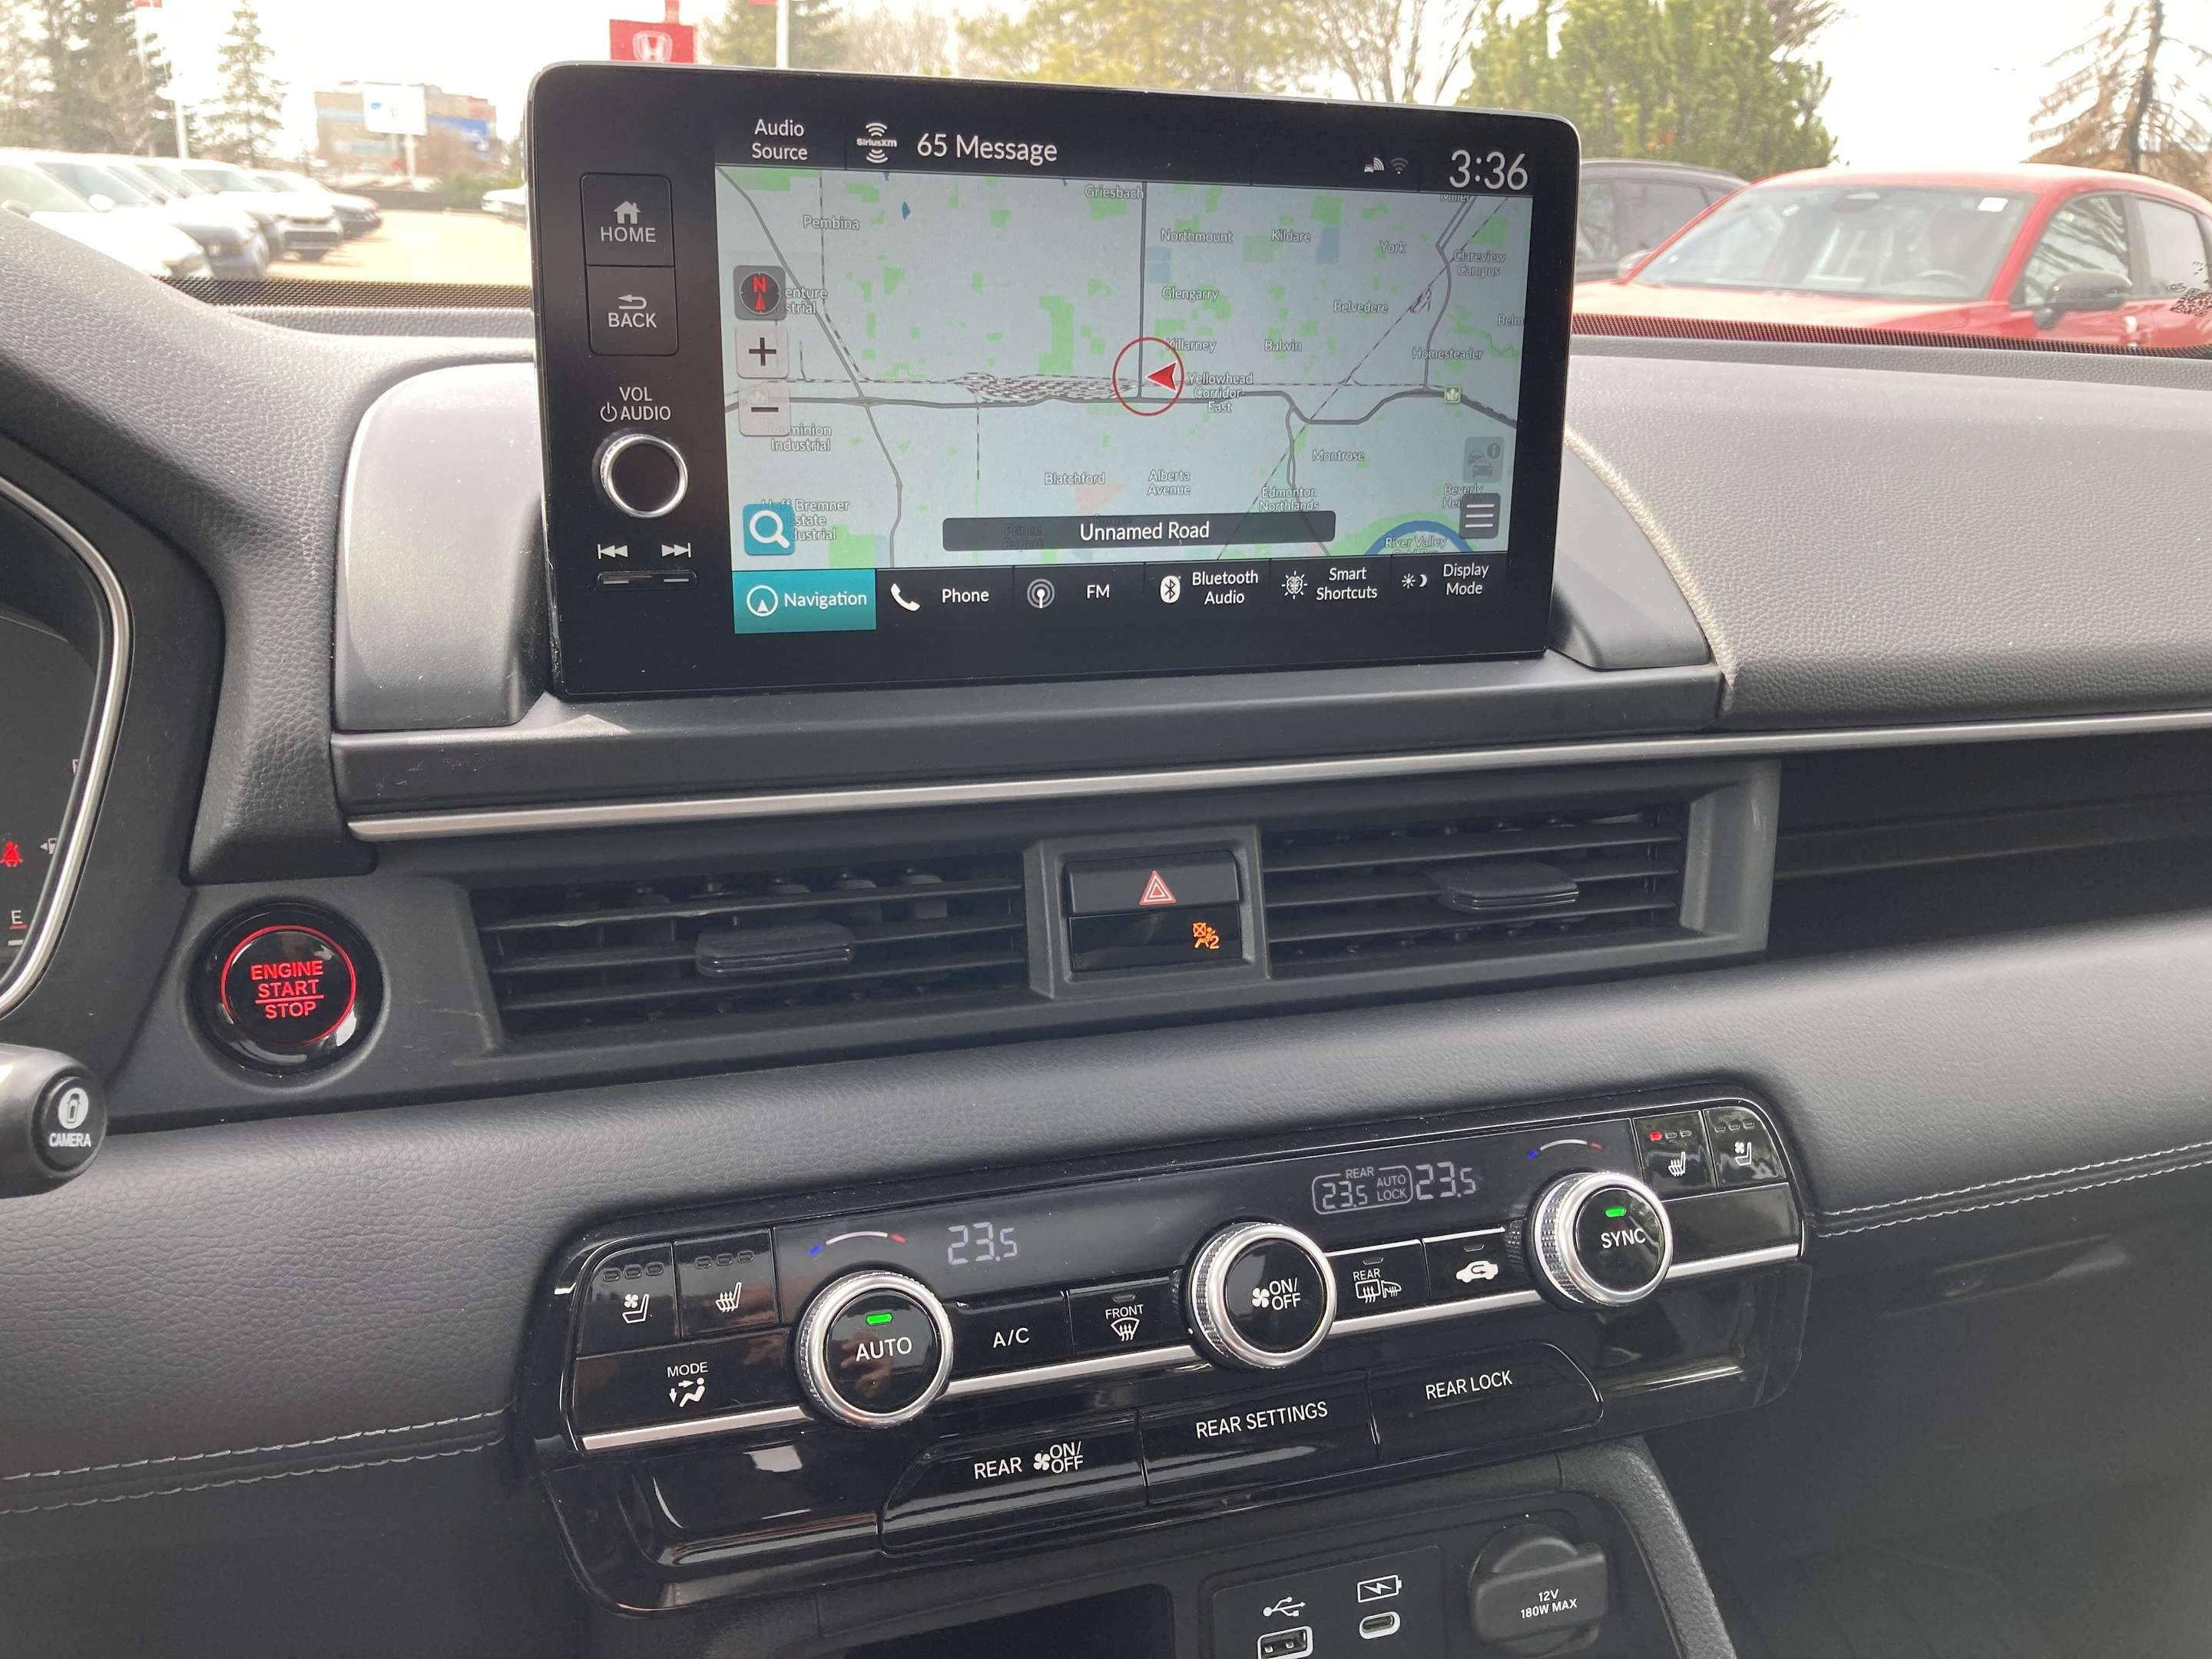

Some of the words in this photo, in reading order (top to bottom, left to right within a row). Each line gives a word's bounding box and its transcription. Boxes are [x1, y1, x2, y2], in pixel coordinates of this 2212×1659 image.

[754, 118, 804, 137] Audio
[752, 142, 808, 161] Source
[917, 133, 947, 157] 65
[956, 134, 1058, 167] Message
[1449, 150, 1528, 190] 3:36
[1084, 185, 1144, 200] Griesbach
[803, 215, 859, 230] Pembina
[601, 227, 656, 243] HOME
[1161, 229, 1233, 243] Northmount
[1271, 229, 1311, 243] Kildare
[1380, 240, 1406, 254] York
[1453, 250, 1505, 263] Clareview
[1457, 264, 1500, 278] Campus
[785, 286, 828, 299] enture
[1161, 286, 1219, 303] Glengarry
[786, 301, 816, 314] strial
[1333, 300, 1388, 313] Belvedere
[608, 312, 657, 329] BACK
[1498, 314, 1525, 326] Belm
[1166, 339, 1216, 354] Killarney
[1264, 339, 1302, 352] Balwin
[1412, 346, 1482, 361] Homesteader
[1187, 372, 1253, 385] Yellowhead
[619, 386, 653, 402] VOL
[1207, 400, 1233, 412] East
[621, 406, 671, 422] AUDIO
[790, 423, 832, 436] minion
[770, 439, 832, 452] Industrial
[1312, 449, 1365, 462] Montrose
[1045, 472, 1105, 485] Blatchford
[1147, 469, 1190, 482] Alberta
[1147, 485, 1190, 495] Avenue
[1261, 485, 1318, 500] Edmonton
[795, 499, 850, 512] Bremner
[1259, 499, 1319, 513] Northlands
[1080, 522, 1163, 541] Unnamed
[1168, 522, 1210, 539] Road
[1385, 537, 1412, 548] River
[1414, 535, 1446, 549] Valley
[1329, 567, 1366, 581] Smart
[1443, 562, 1489, 578] Display
[1192, 570, 1259, 587] Bluetooth
[942, 588, 989, 603] Phone
[1086, 584, 1111, 599] FM
[1316, 584, 1377, 601] Shortcuts
[1446, 581, 1483, 595] Mode
[784, 591, 867, 609] Navigation
[1204, 589, 1245, 605] Audio
[250, 960, 323, 981] ENGINE
[257, 979, 320, 998] START
[264, 1001, 316, 1019] STOP
[48, 1133, 92, 1148] CAMERA
[1346, 1167, 1374, 1179] REAR
[1416, 1161, 1476, 1200] 23.5
[1376, 1174, 1406, 1188] AUTO
[1377, 1188, 1407, 1202] LOCK
[948, 1221, 1018, 1266] 23.5
[1600, 1227, 1646, 1250] SYNC
[1353, 1268, 1381, 1281] REAR
[1269, 1277, 1298, 1294] ON/
[1272, 1293, 1302, 1310] OFF
[1104, 1304, 1144, 1319] FRONT
[992, 1327, 1030, 1348] A/C
[855, 1336, 912, 1362] AUTO
[667, 1361, 708, 1379] MODE
[1425, 1378, 1469, 1400] REAR
[1470, 1369, 1512, 1392] LOCK
[1196, 1416, 1242, 1439] REAR
[1247, 1401, 1328, 1430] SETTINGS
[1050, 1441, 1081, 1461] ON/
[974, 1457, 1022, 1479] REAR
[1051, 1455, 1084, 1474] OFF
[1538, 1588, 1559, 1602] 12V
[1520, 1603, 1550, 1619] 180W
[1551, 1598, 1578, 1612] MAX
